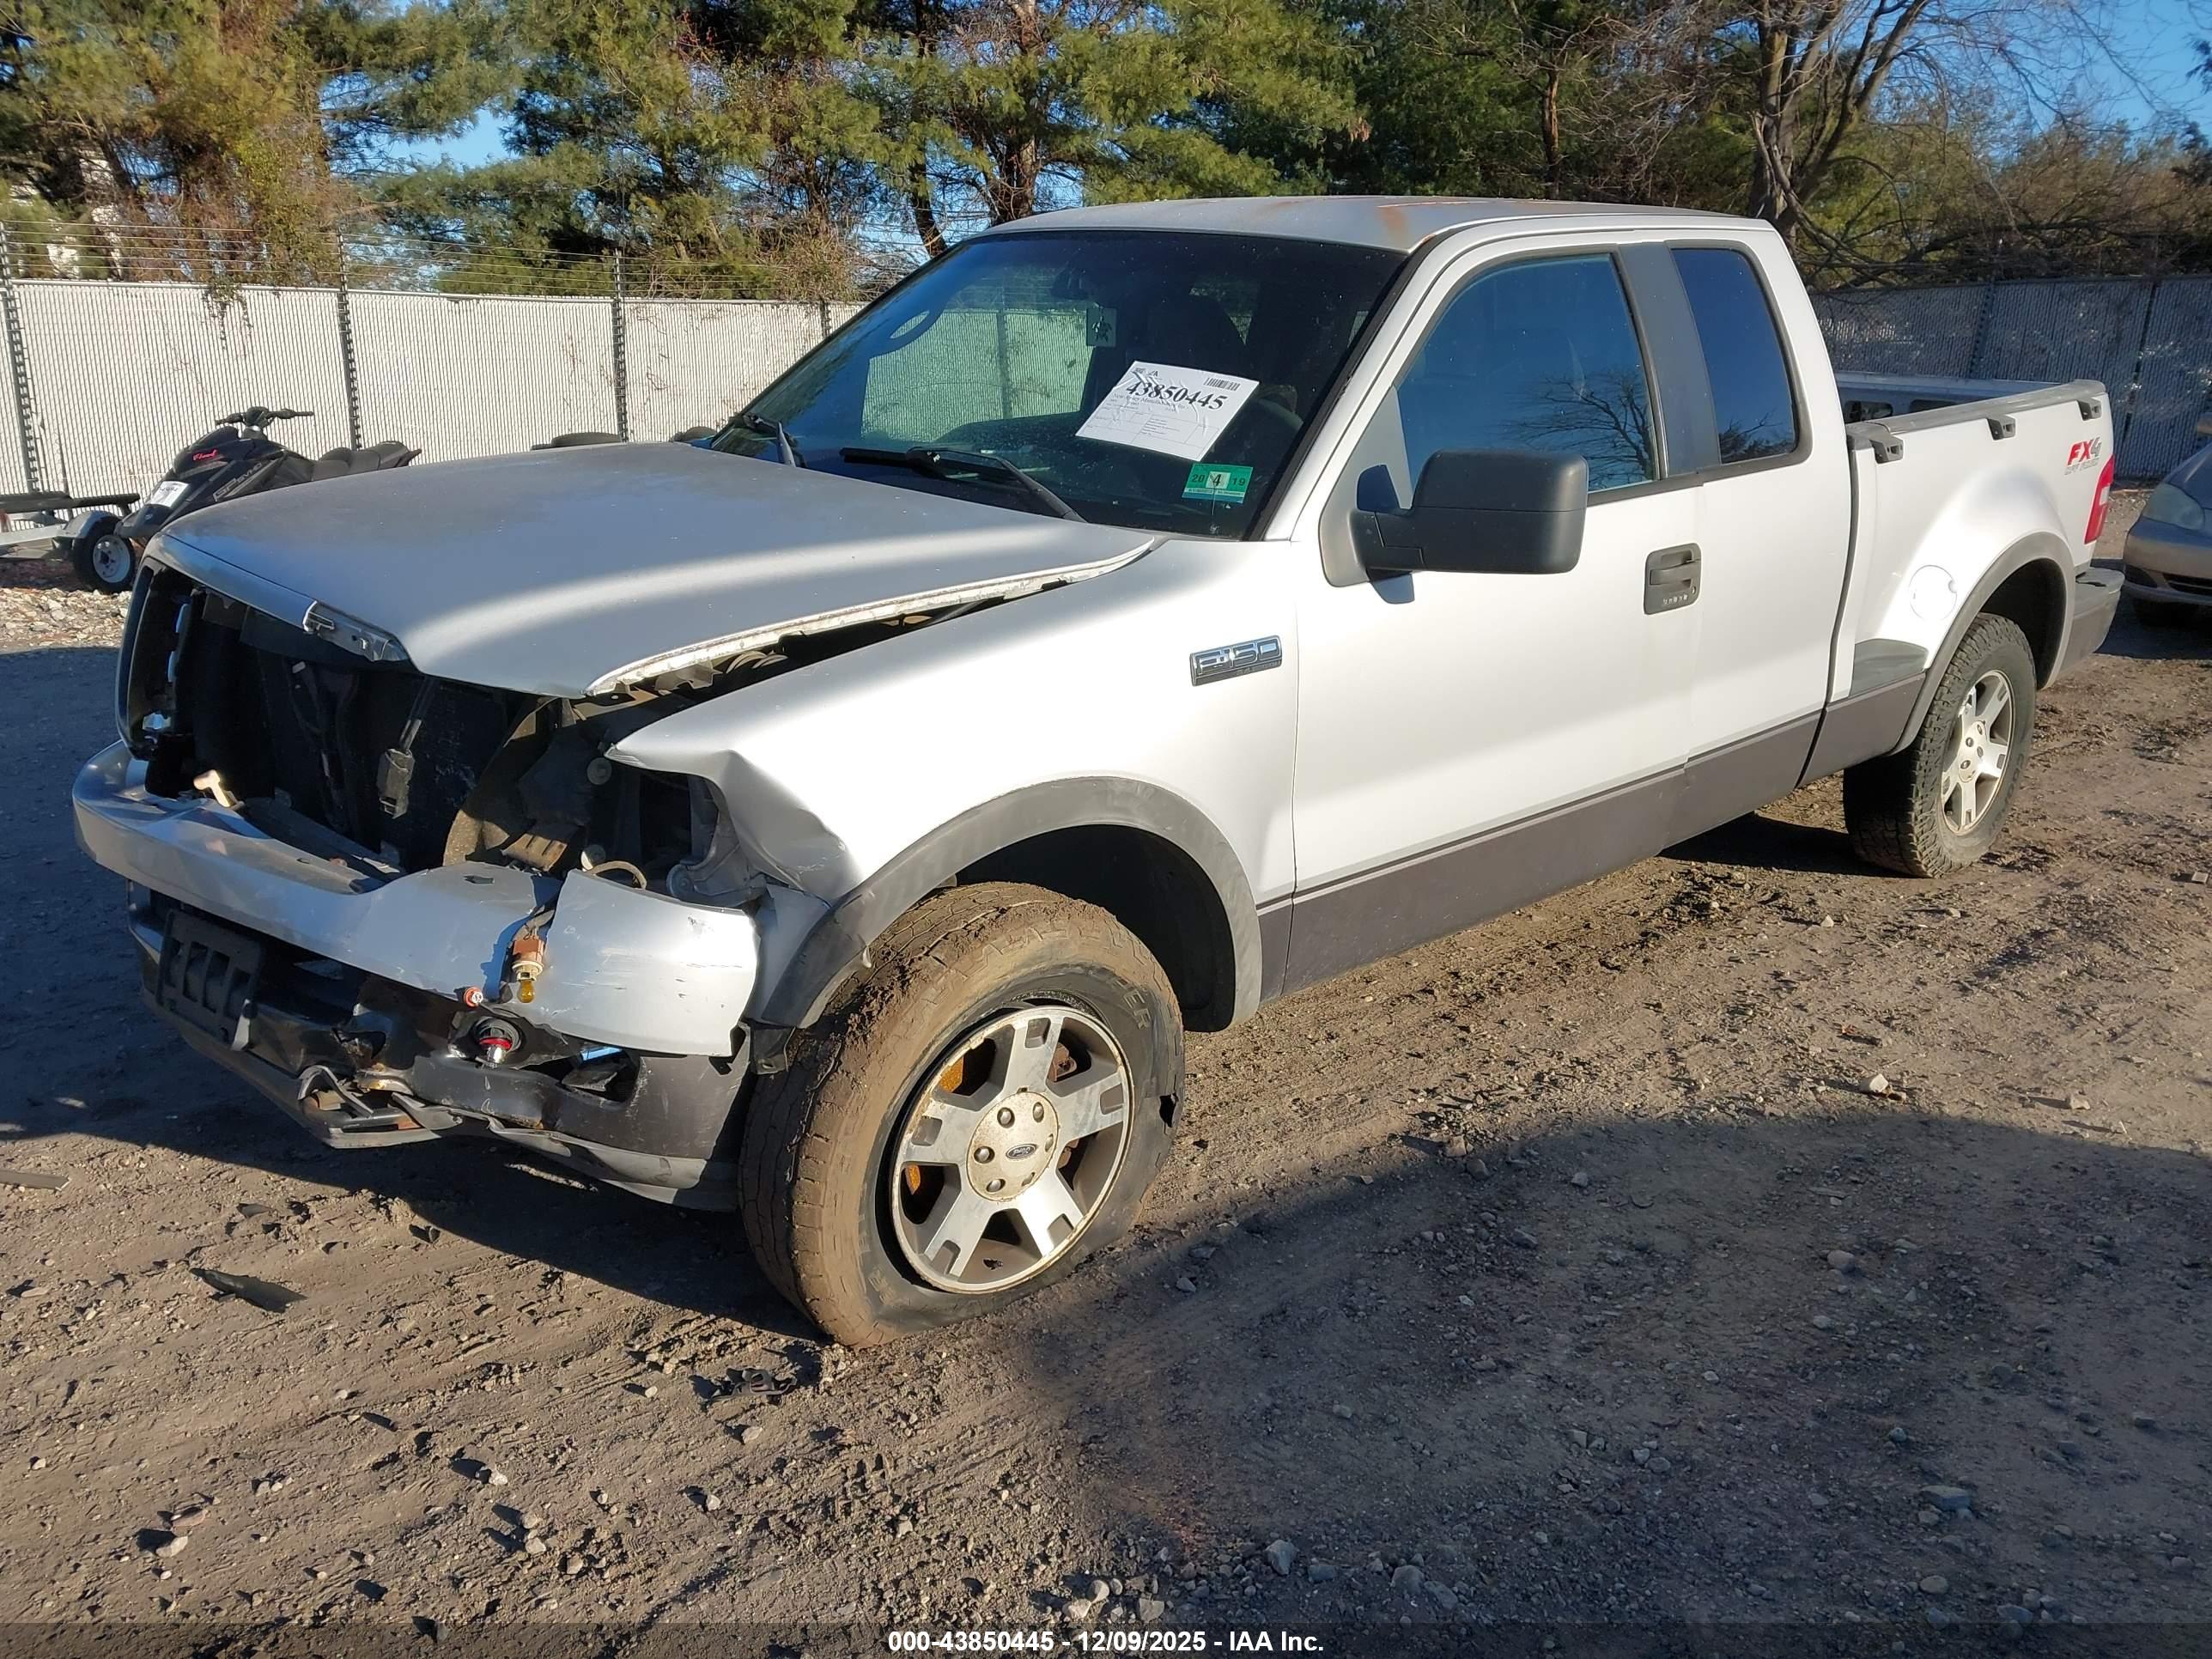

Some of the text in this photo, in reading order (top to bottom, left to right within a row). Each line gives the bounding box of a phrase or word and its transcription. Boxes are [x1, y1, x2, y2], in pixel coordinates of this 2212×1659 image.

[1126, 381, 1228, 410] 43850445
[2067, 436, 2102, 466] FX4
[1191, 473, 1246, 486] 20 4 19
